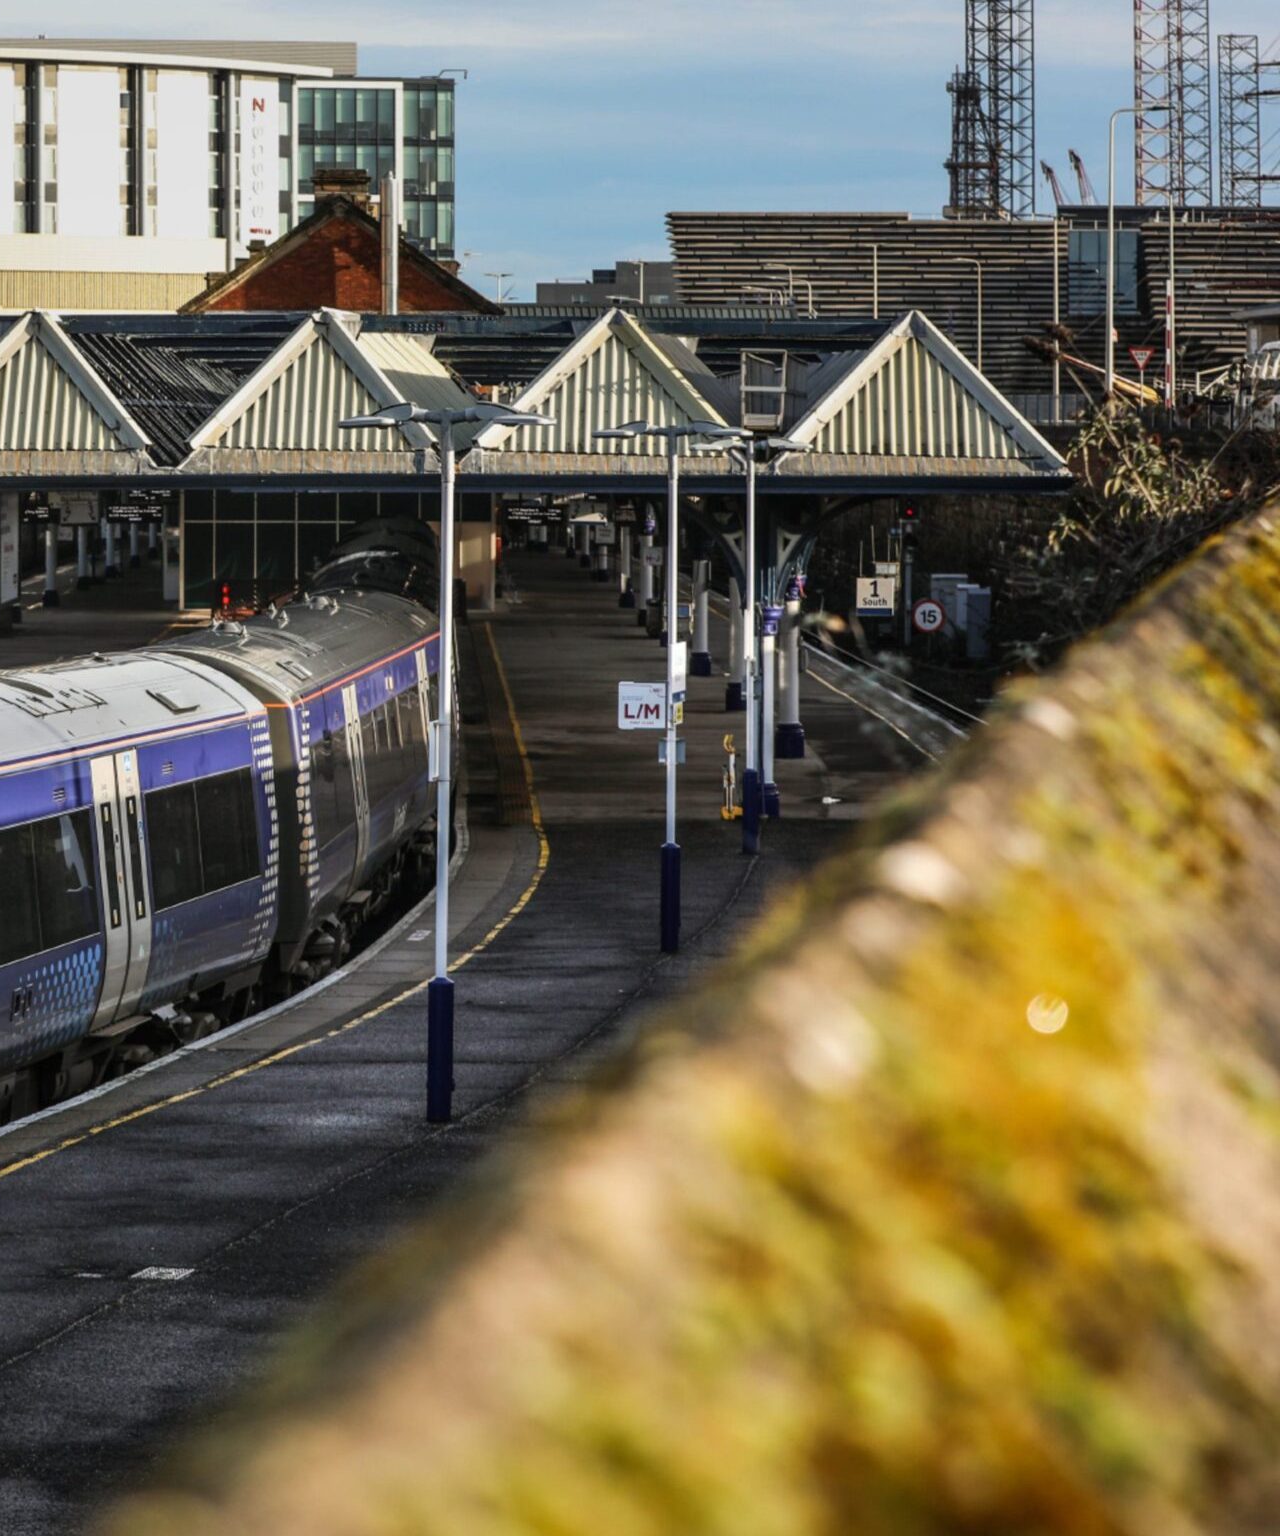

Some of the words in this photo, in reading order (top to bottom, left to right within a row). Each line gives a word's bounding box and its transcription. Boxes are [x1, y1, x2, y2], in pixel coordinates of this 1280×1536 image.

[870, 580, 879, 597] 1
[862, 598, 888, 606] South
[920, 610, 937, 624] 15
[624, 703, 660, 720] L/M
